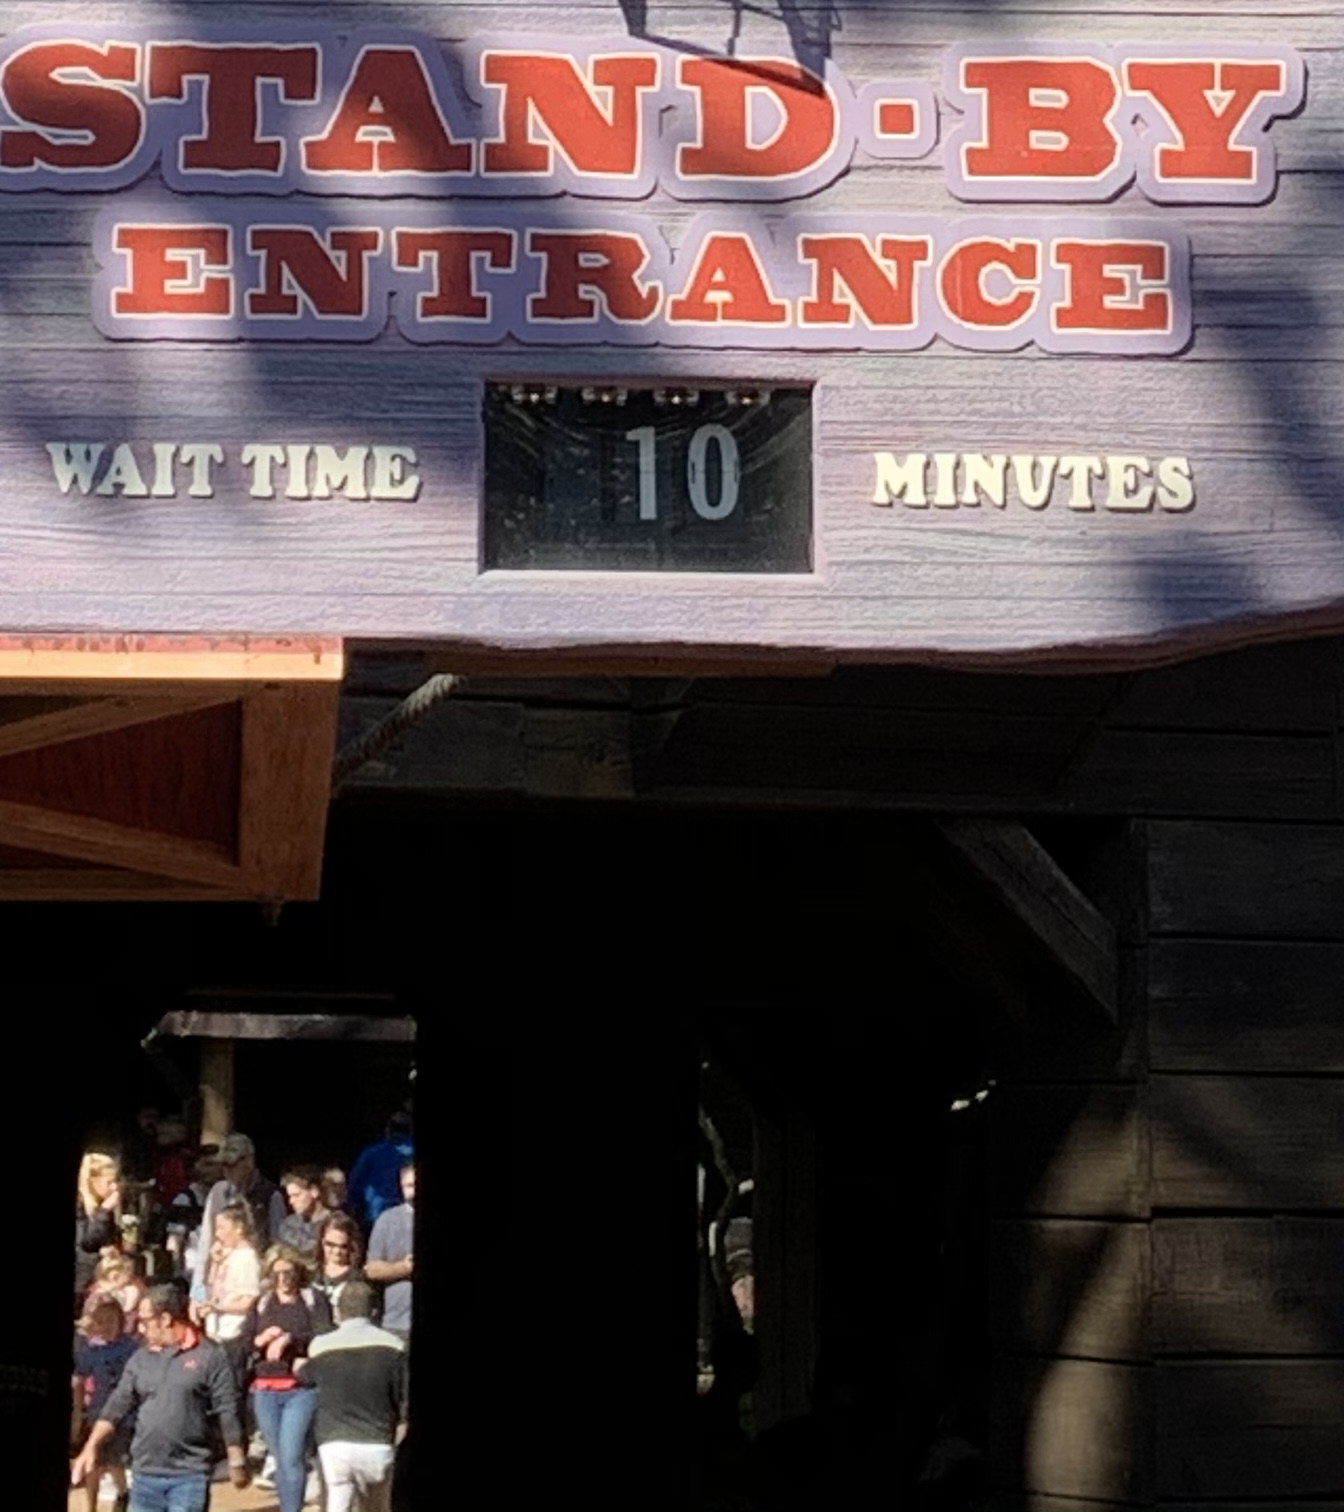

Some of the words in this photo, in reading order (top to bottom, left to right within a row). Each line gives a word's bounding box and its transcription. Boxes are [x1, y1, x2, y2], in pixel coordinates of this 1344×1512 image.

[109, 223, 1173, 334] ENTRANCE
[45, 442, 224, 498] WAIT
[241, 443, 421, 502] TIME
[626, 423, 742, 522] 10
[871, 451, 1196, 512] MINUTES
